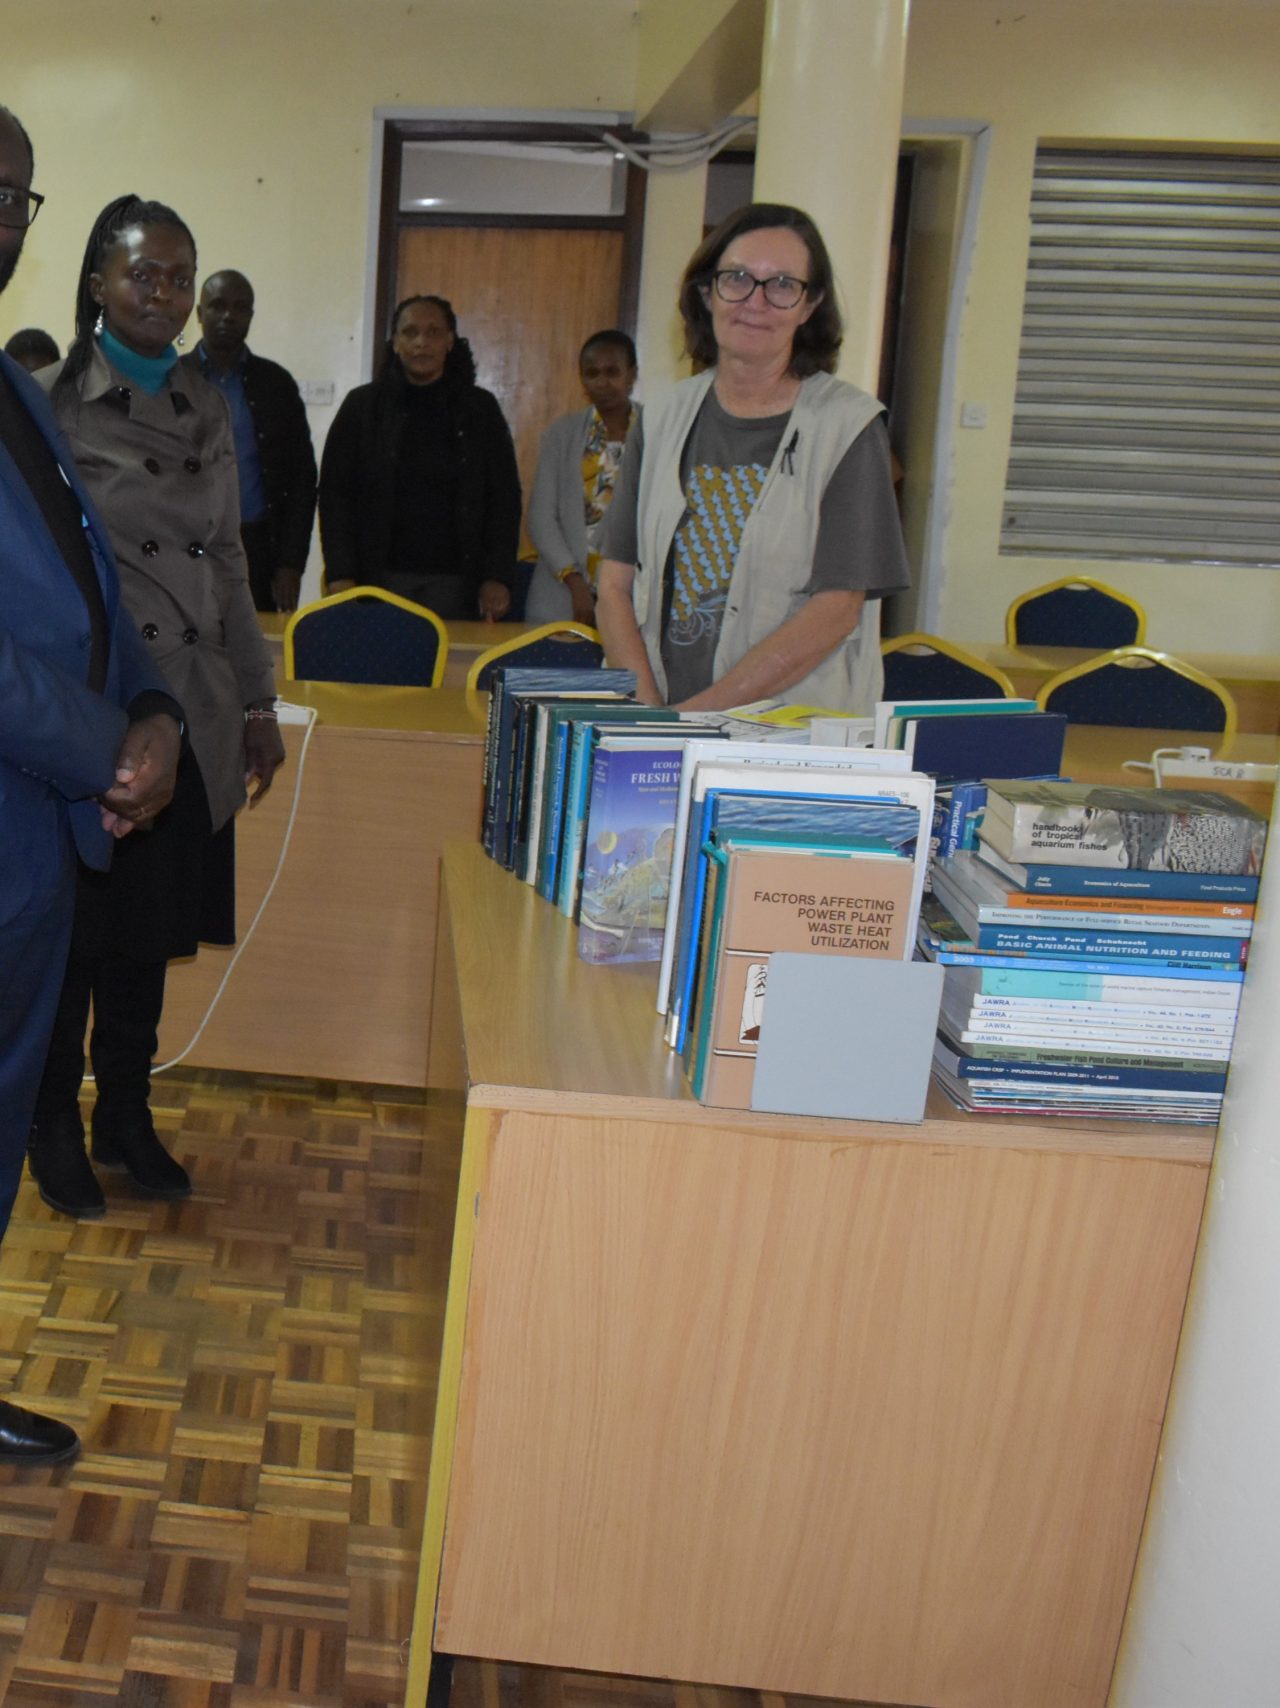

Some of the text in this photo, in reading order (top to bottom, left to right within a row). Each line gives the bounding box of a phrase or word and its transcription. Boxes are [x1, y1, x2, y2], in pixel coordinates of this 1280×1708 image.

[631, 773, 670, 784] FRESH
[951, 801, 963, 838] Practical
[1032, 823, 1081, 834] handbook
[1032, 831, 1083, 842] of tropical
[1031, 840, 1108, 851] aquarium fishes
[754, 891, 895, 911] FACTORS AFFECTING
[798, 908, 894, 925] POWER PLANT
[1222, 906, 1243, 916] Engle
[808, 921, 892, 938] WASTE HEAT
[811, 935, 890, 951] UTILIZATION
[996, 941, 1033, 950] BASIC
[1035, 942, 1082, 952] ANIMAL
[1086, 944, 1149, 955] NUTRITION
[1152, 948, 1178, 957] AND
[1181, 950, 1231, 959] FEEDING
